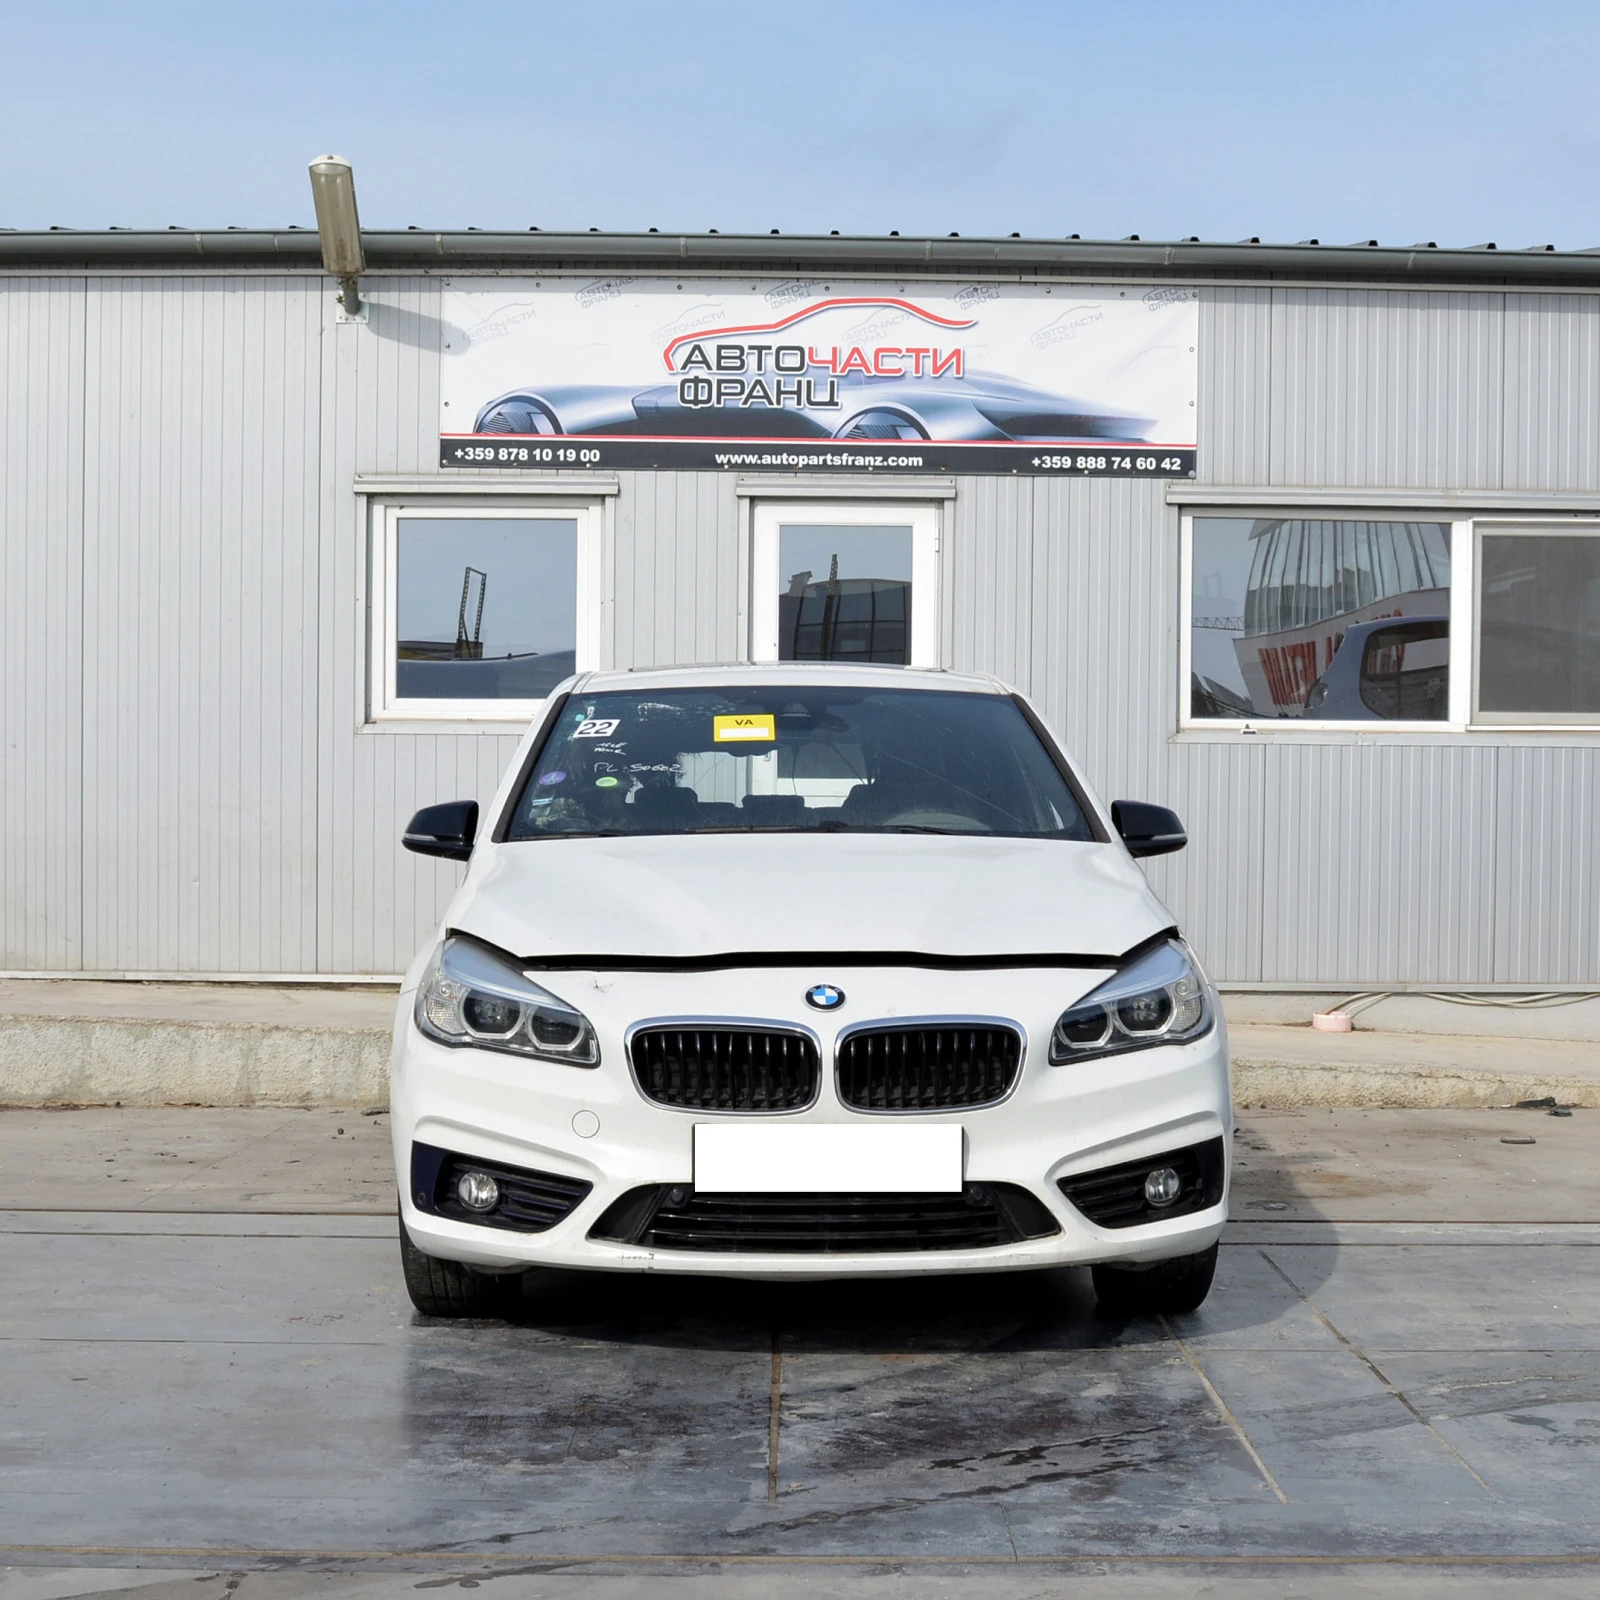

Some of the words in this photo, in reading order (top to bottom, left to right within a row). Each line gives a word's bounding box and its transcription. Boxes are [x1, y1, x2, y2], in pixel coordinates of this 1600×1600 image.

[680, 344, 961, 375] АВТОЧАСТИ
[679, 376, 839, 406] ФРАНЦ
[454, 447, 495, 461] +359
[498, 447, 529, 461] 878
[533, 448, 552, 461] 10
[557, 448, 576, 462] 19
[580, 449, 600, 462] 00
[715, 452, 923, 467] www.autopartsfranz.com
[1031, 455, 1072, 468] +359
[1076, 456, 1107, 469] 888
[1111, 457, 1132, 469] 74
[1136, 457, 1156, 470] 60
[1161, 457, 1181, 470] 42
[577, 721, 613, 735] 22
